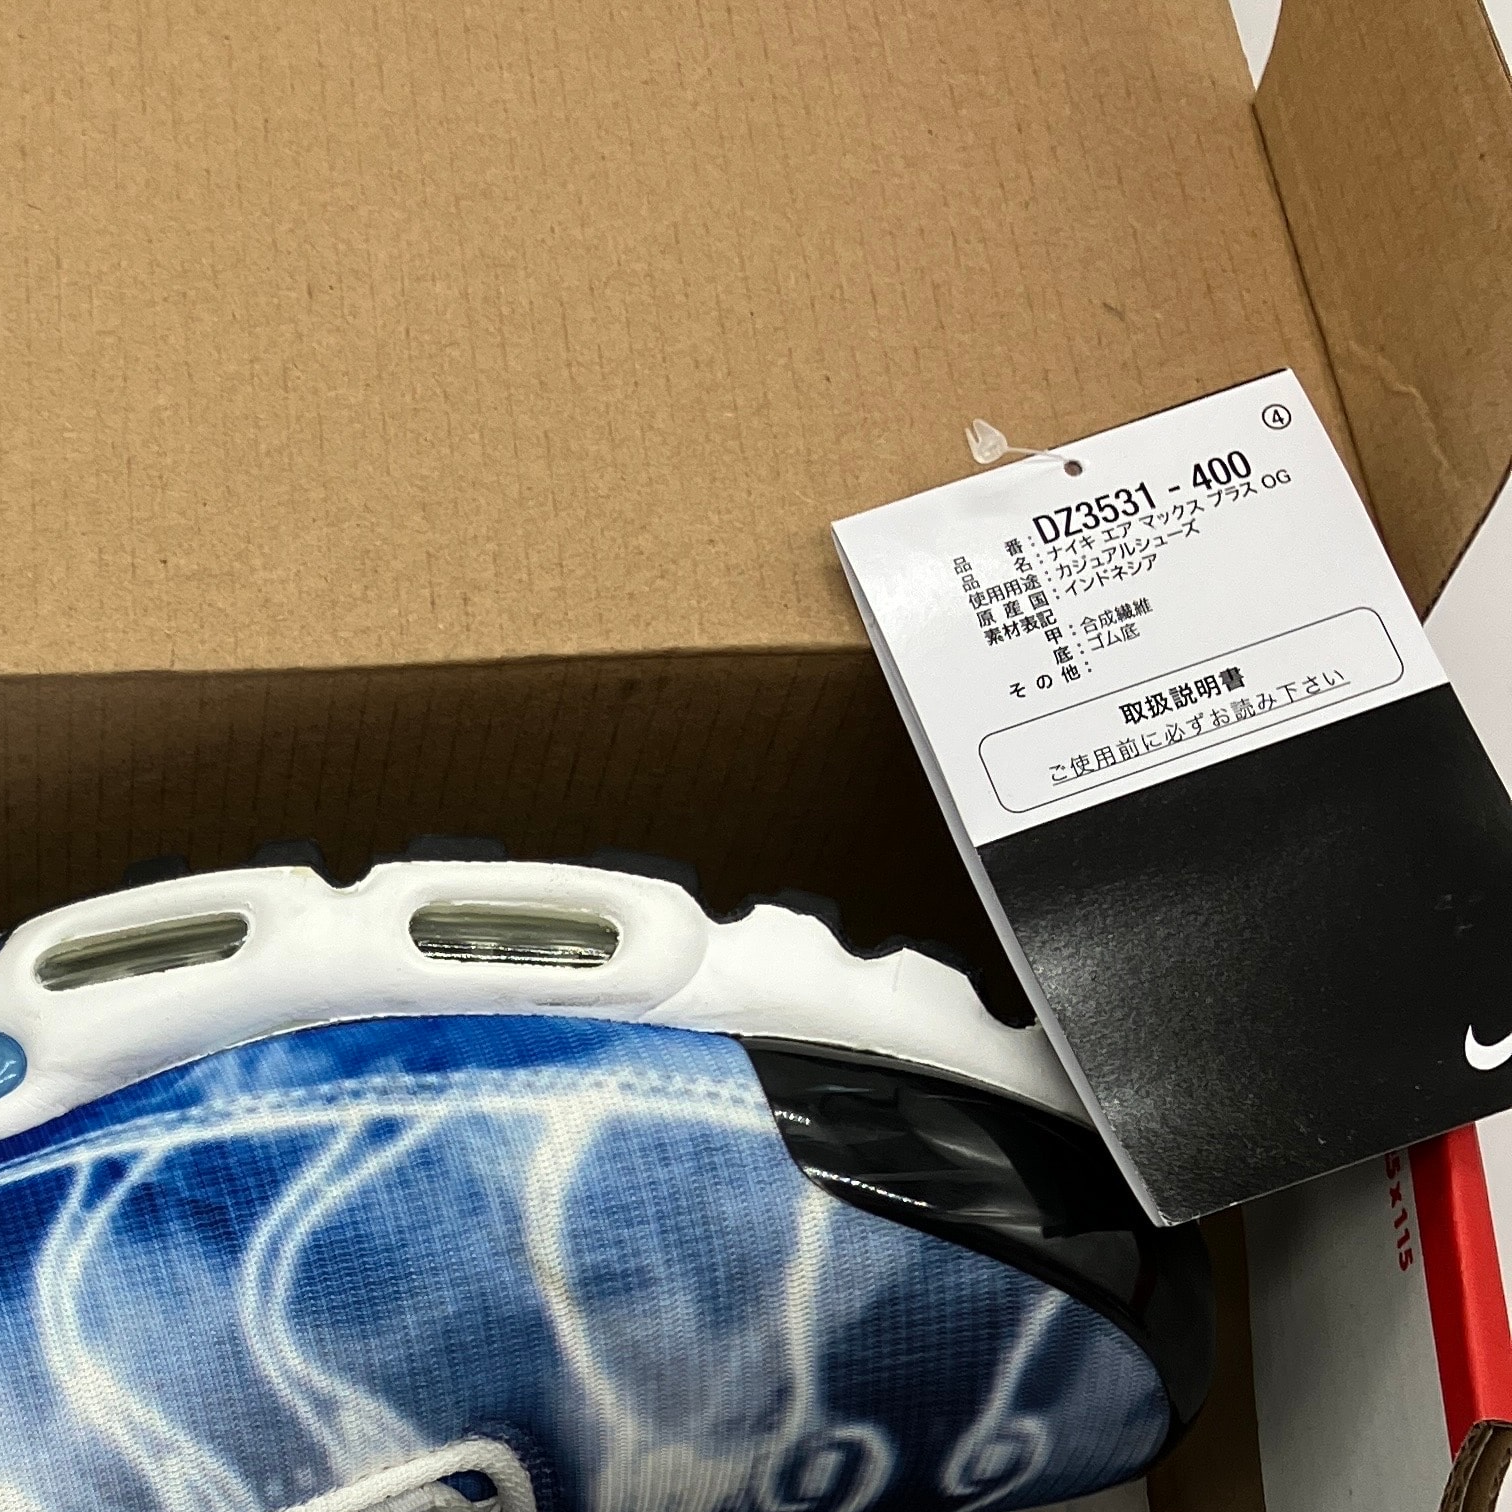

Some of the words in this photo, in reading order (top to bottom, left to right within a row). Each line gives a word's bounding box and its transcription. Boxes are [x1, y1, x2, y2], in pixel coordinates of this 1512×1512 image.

[1032, 481, 1156, 545] DZ3531
[1168, 485, 1181, 493] -
[1192, 450, 1252, 491] 400
[1047, 535, 1096, 562] ナイキ
[1101, 520, 1132, 543] エア
[1138, 499, 1205, 530] マックス
[1206, 481, 1258, 508] プラス
[1261, 469, 1292, 489] OG
[1065, 553, 1157, 597] インドネシア
[983, 608, 1058, 647] 素材表記
[1080, 597, 1154, 635] 合成繊維
[1087, 622, 1141, 651] ゴム底
[1118, 666, 1245, 725] 取扱説明書
[1384, 1151, 1414, 1272] 5x115
